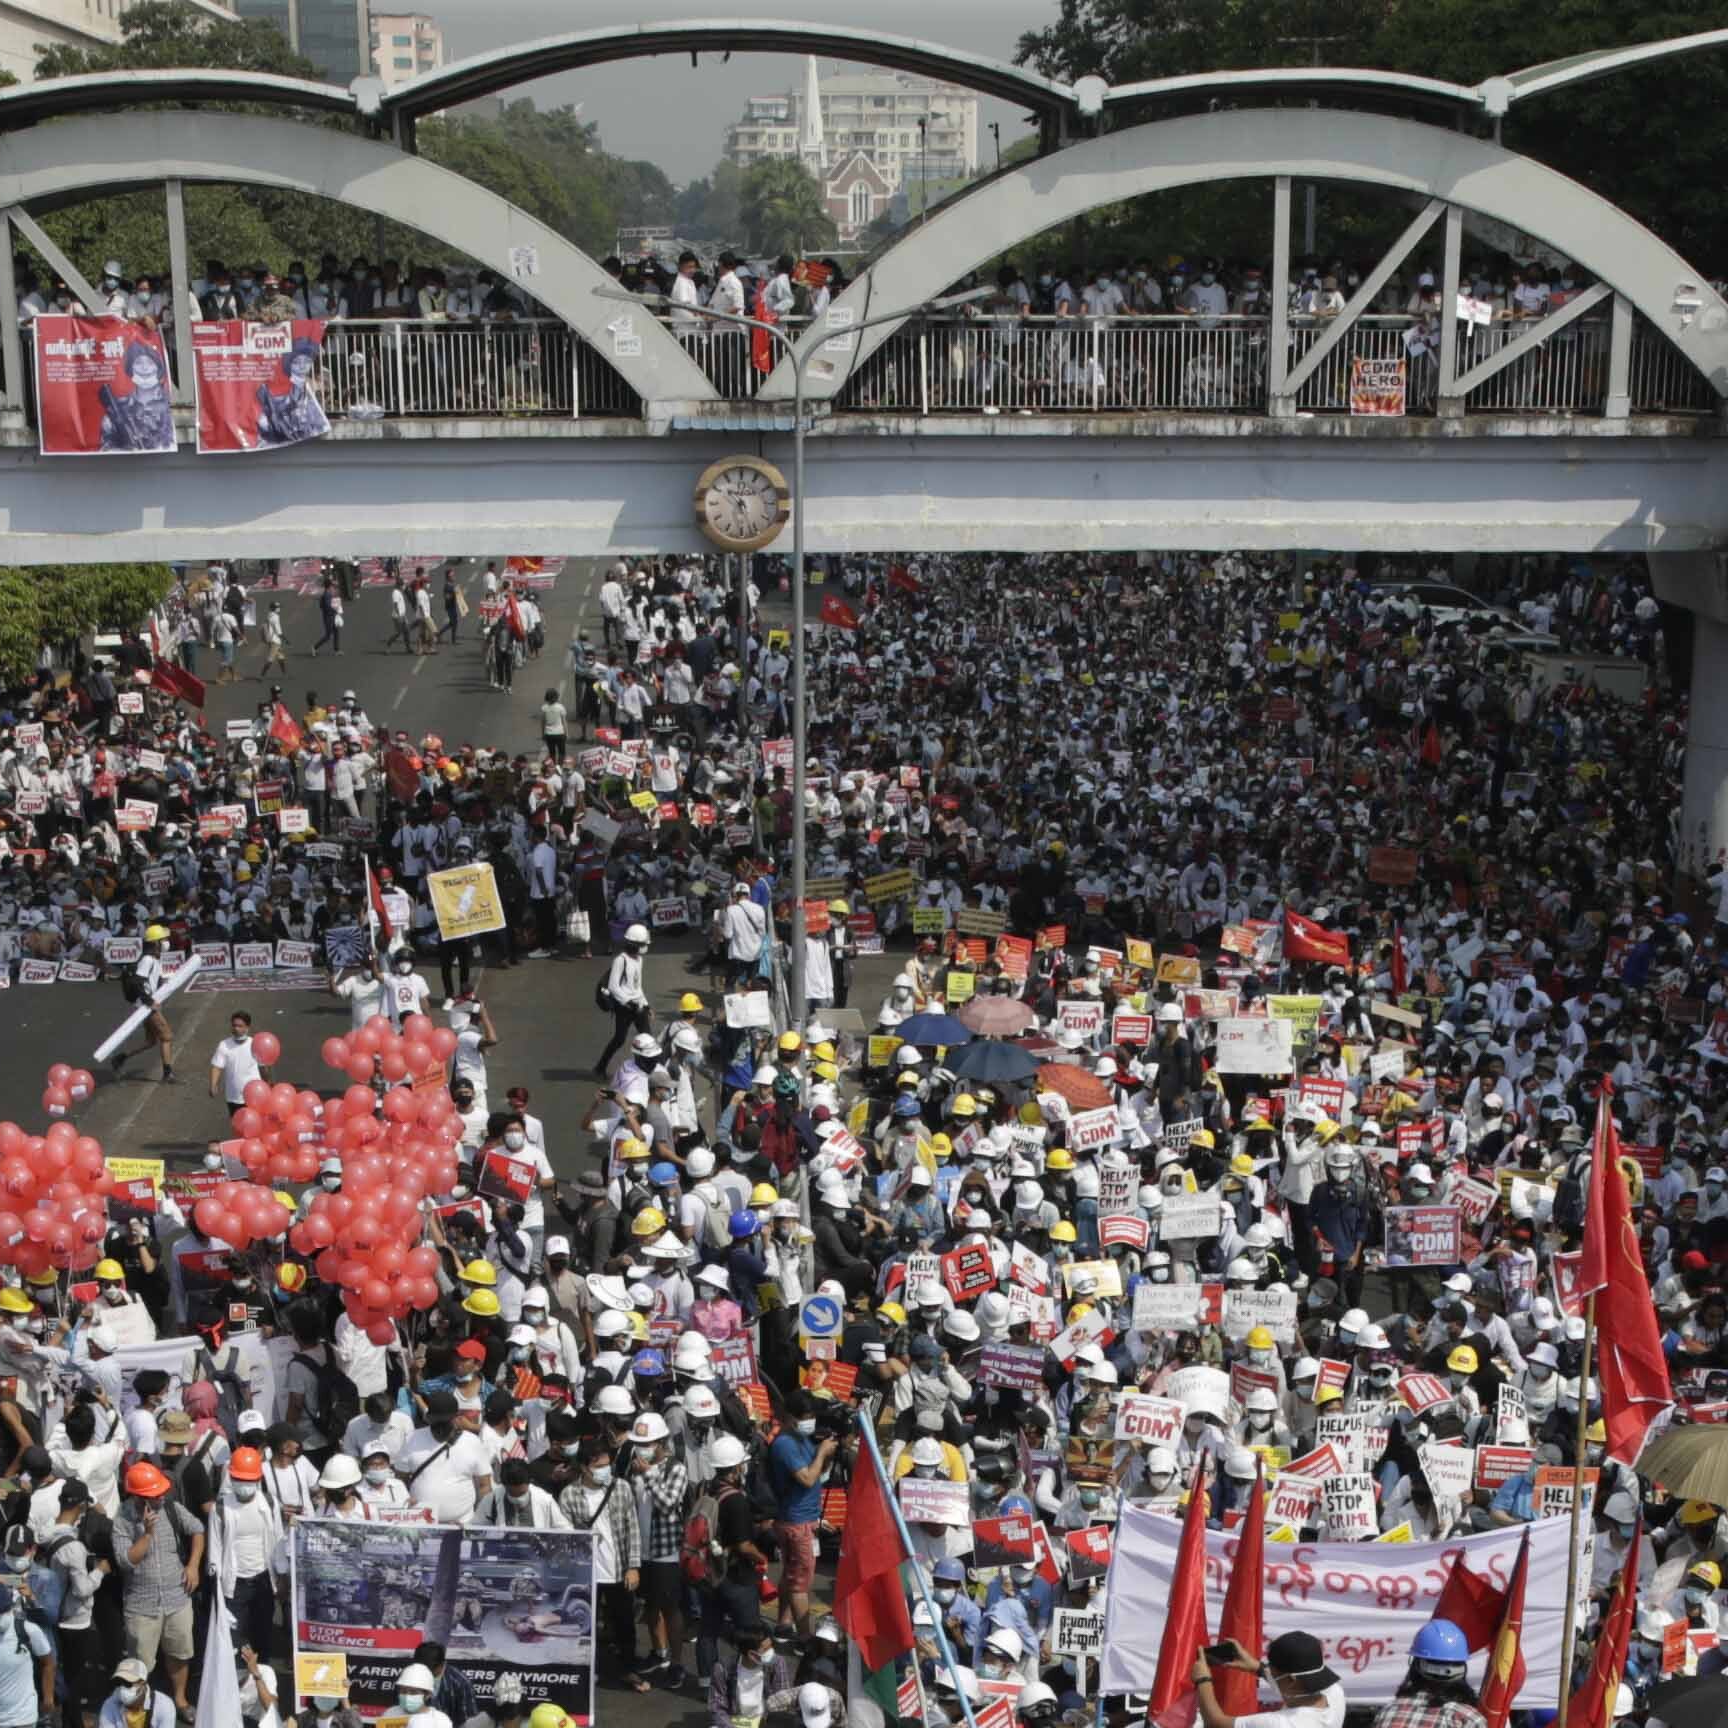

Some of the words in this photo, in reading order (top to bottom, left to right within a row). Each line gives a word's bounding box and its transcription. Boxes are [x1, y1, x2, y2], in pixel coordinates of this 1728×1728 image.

[255, 335, 287, 349] CDM
[656, 909, 684, 922] CDM
[111, 949, 138, 960] CDM
[200, 954, 226, 966] CDM
[280, 952, 308, 965] CDM
[240, 956, 269, 968] CDM
[1063, 1017, 1097, 1030] CDM
[1079, 1125, 1115, 1145] CDM
[1100, 1170, 1125, 1183] HELP
[1100, 1184, 1129, 1196] STOP
[1452, 1192, 1486, 1218] CDM
[1412, 1233, 1453, 1251] CDM
[1124, 1413, 1172, 1441] CDM
[1319, 1418, 1348, 1432] HELP
[1348, 1417, 1363, 1431] US
[1324, 1477, 1356, 1495] HELP
[1357, 1475, 1372, 1491] US
[1327, 1496, 1364, 1512] STOP
[1329, 1512, 1370, 1529] CRIME
[308, 1625, 345, 1636] STOP
[308, 1635, 376, 1648] VIOLENCE
